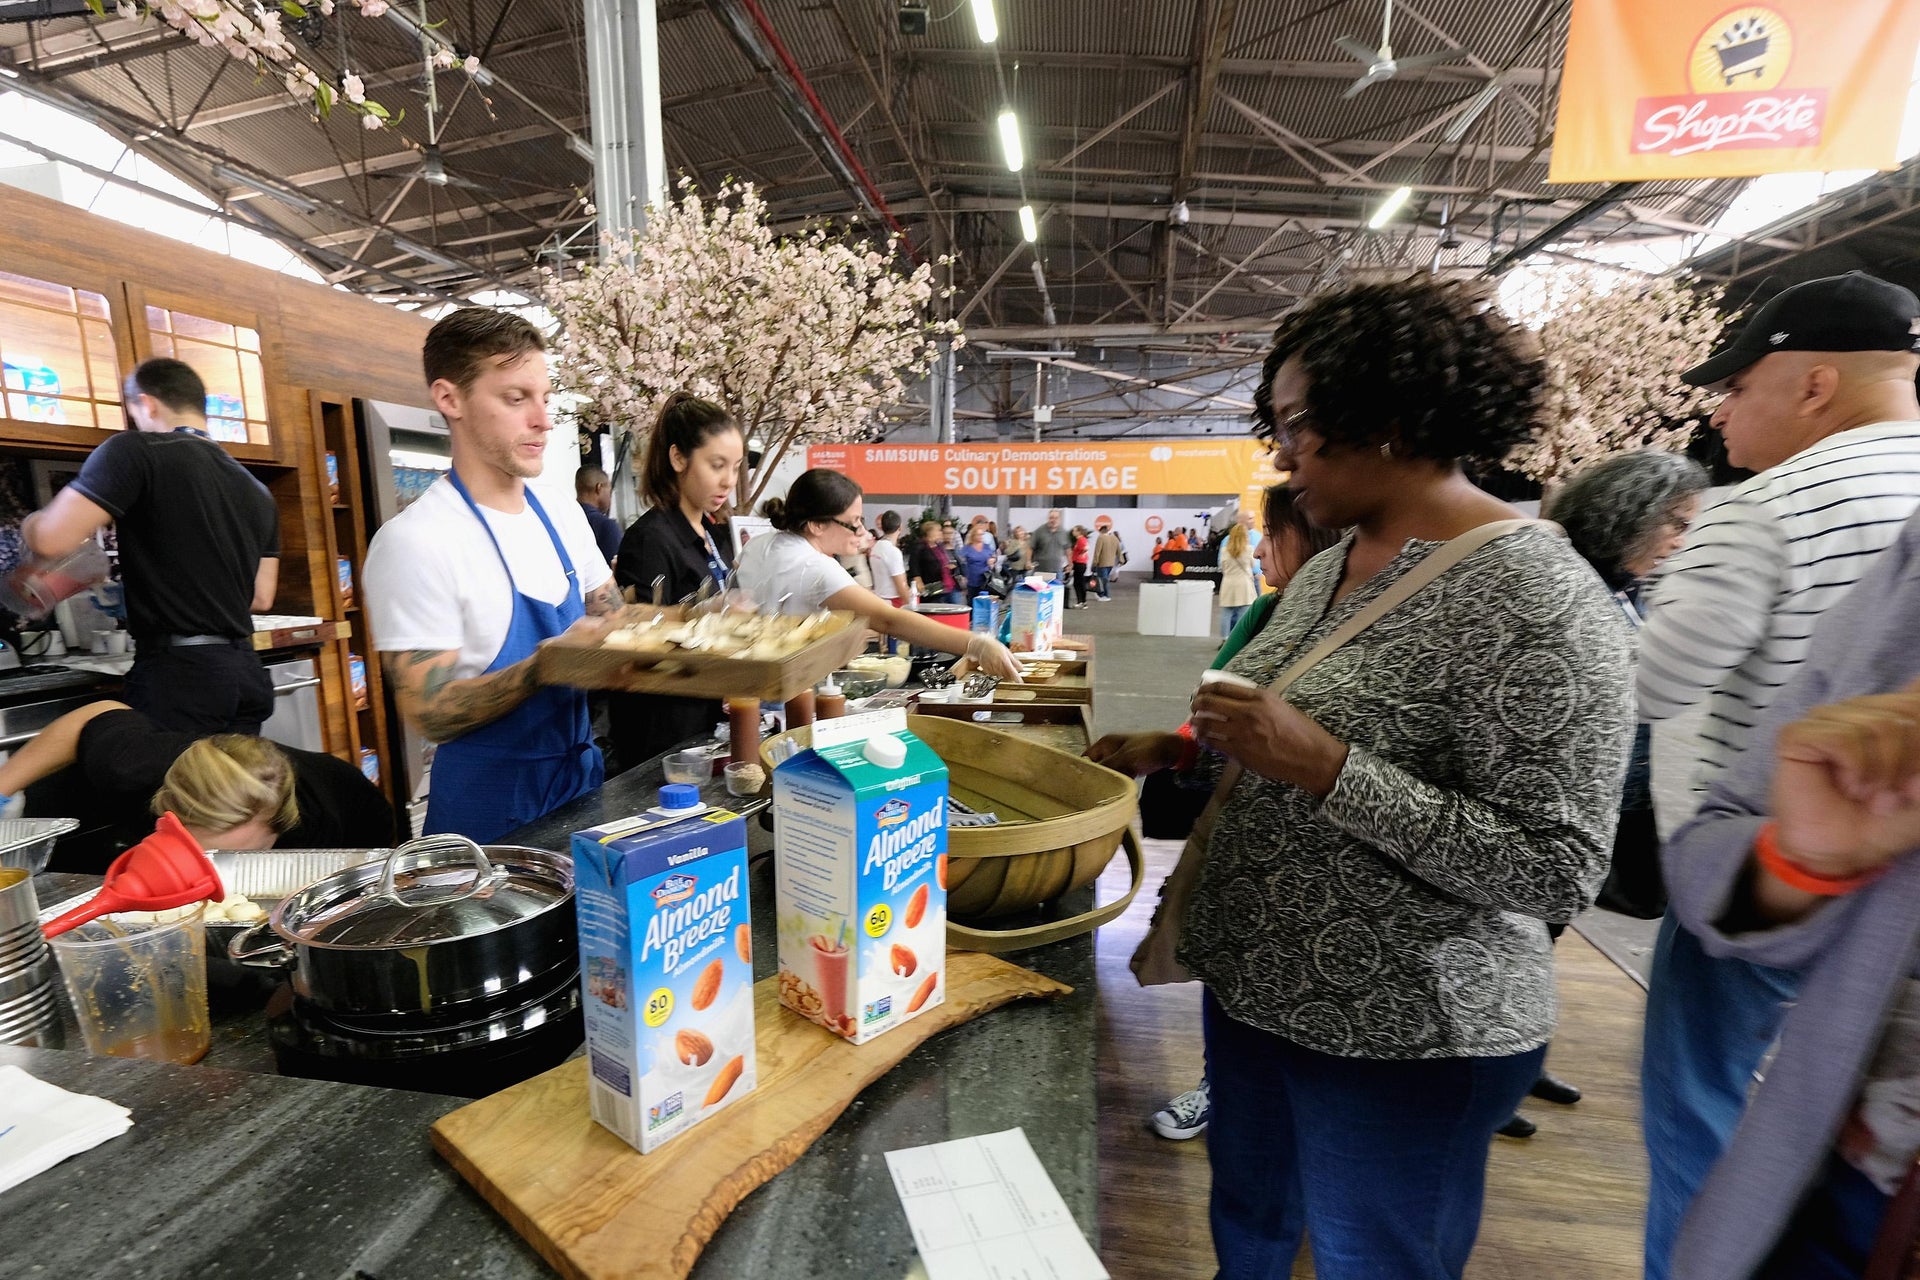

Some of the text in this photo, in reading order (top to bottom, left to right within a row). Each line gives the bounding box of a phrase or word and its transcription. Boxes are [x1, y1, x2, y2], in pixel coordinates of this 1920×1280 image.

[1637, 94, 1818, 153] ShopRite
[865, 448, 1108, 464] SAMSUNG Culinary Demonstrations
[944, 466, 1139, 490] SOUTH STAGE
[667, 847, 709, 866] Vanilla
[863, 796, 944, 876] Almond
[883, 833, 937, 891] Breeze
[640, 865, 740, 962] Almond
[871, 910, 887, 925] 60
[663, 905, 731, 974] Breeze
[650, 994, 668, 1014] 80
